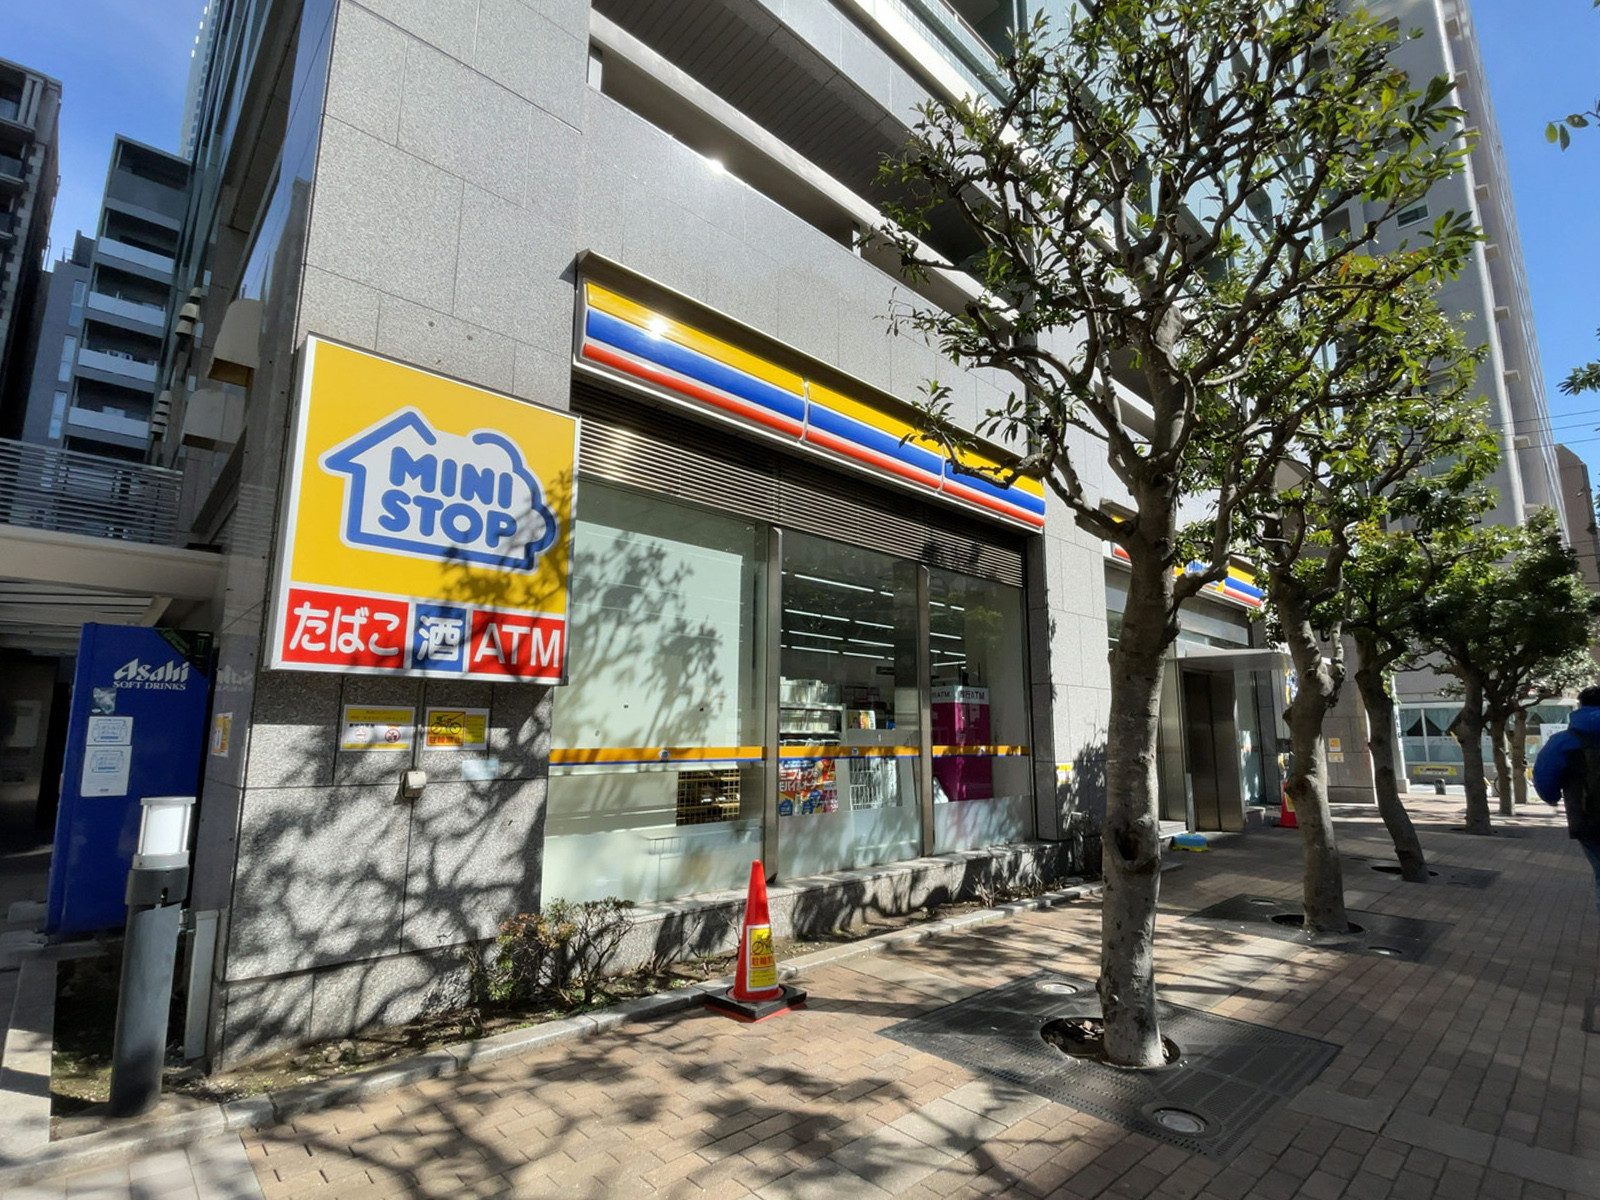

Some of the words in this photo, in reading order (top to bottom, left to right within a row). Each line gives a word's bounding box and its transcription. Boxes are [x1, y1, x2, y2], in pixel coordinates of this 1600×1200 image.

[389, 446, 513, 509] MINI
[378, 489, 517, 548] STOP
[289, 601, 400, 656] たばこ
[418, 615, 463, 661] 酒
[474, 622, 560, 668] ATM
[113, 681, 142, 689] SOFT
[145, 682, 186, 690] DRINKS
[114, 658, 190, 682] Asahi
